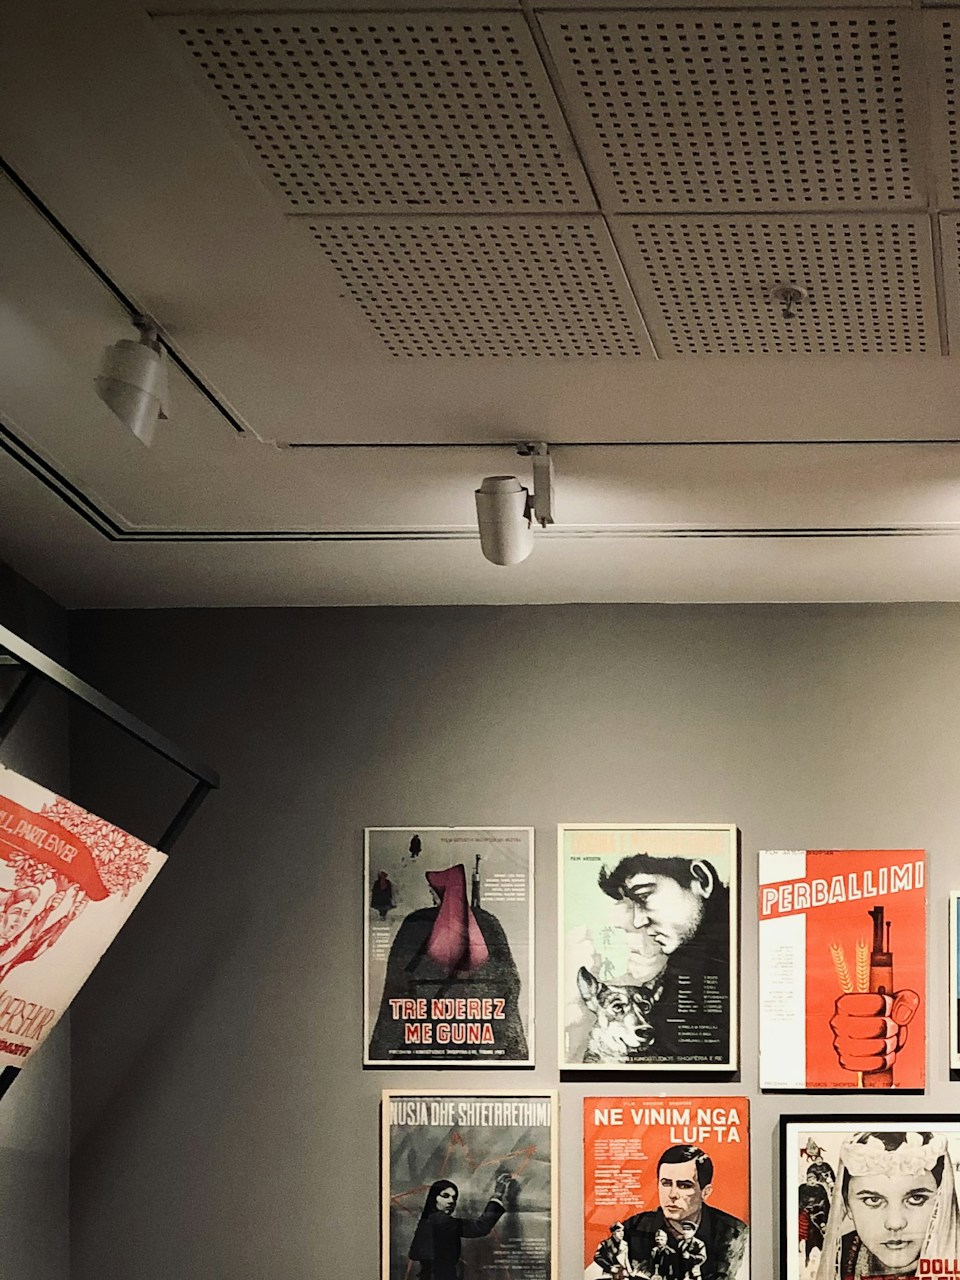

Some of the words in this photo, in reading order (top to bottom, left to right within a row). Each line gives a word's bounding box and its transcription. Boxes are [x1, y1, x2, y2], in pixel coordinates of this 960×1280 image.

[43, 834, 79, 864] ENVER
[762, 861, 924, 916] PERBALLIMI
[389, 998, 427, 1020] TRE
[431, 998, 505, 1020] NJEREZ
[405, 1023, 433, 1045] ME
[436, 1022, 495, 1045] GUNA
[390, 1101, 428, 1126] NUSJA
[431, 1102, 456, 1126] DHE
[594, 1108, 624, 1126] NE
[631, 1108, 690, 1126] VINIM
[697, 1108, 740, 1125] NGA
[670, 1126, 741, 1144] LUFTA
